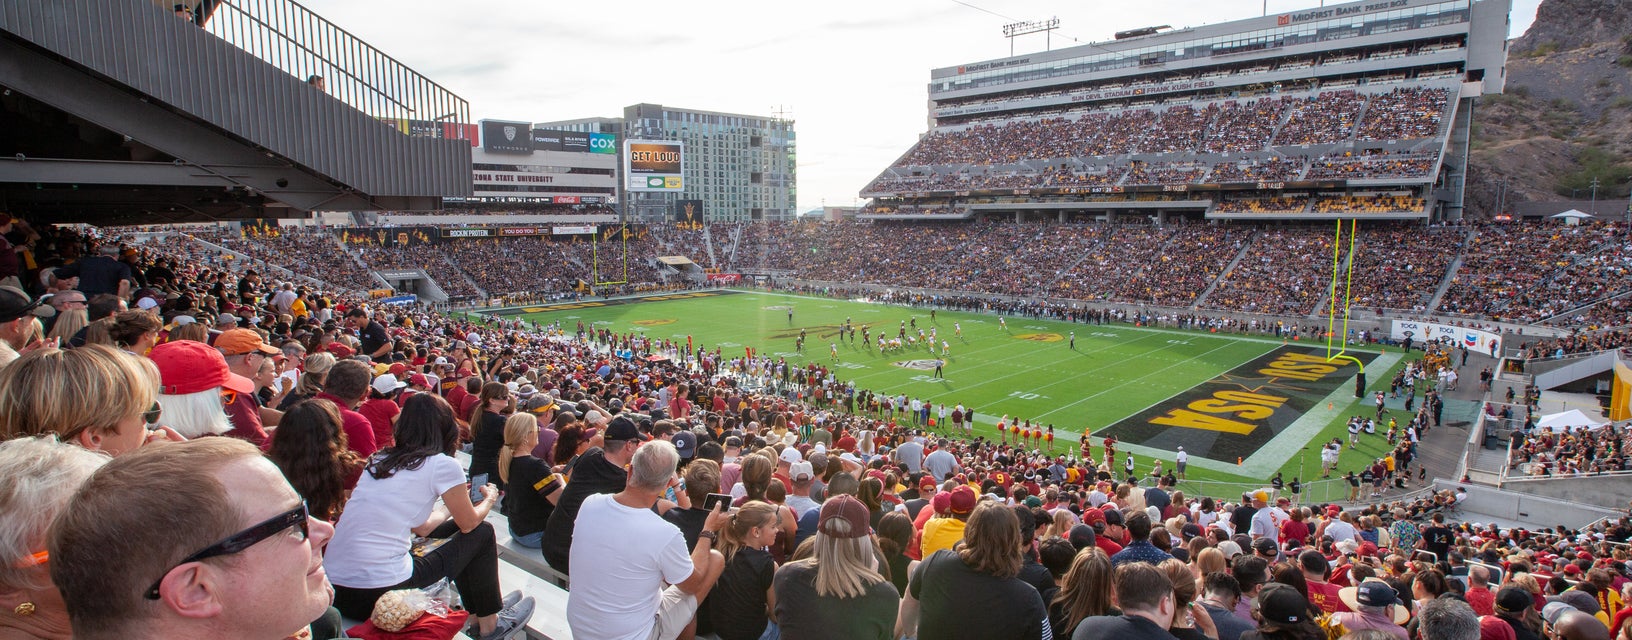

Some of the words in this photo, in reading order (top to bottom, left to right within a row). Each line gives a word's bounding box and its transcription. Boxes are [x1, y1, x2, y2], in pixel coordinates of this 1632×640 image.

[1336, 6, 1361, 16] BANK
[1365, 3, 1388, 11] PRESS
[1104, 90, 1130, 98] STADIUM
[1147, 85, 1170, 94] FRANK
[590, 138, 615, 149] COX
[632, 151, 651, 162] GET
[654, 152, 680, 163] LOUD
[517, 175, 553, 183] UNIVERSITY
[1259, 352, 1354, 382] ASU
[1148, 390, 1290, 436] USA
[996, 473, 1005, 484] 9
